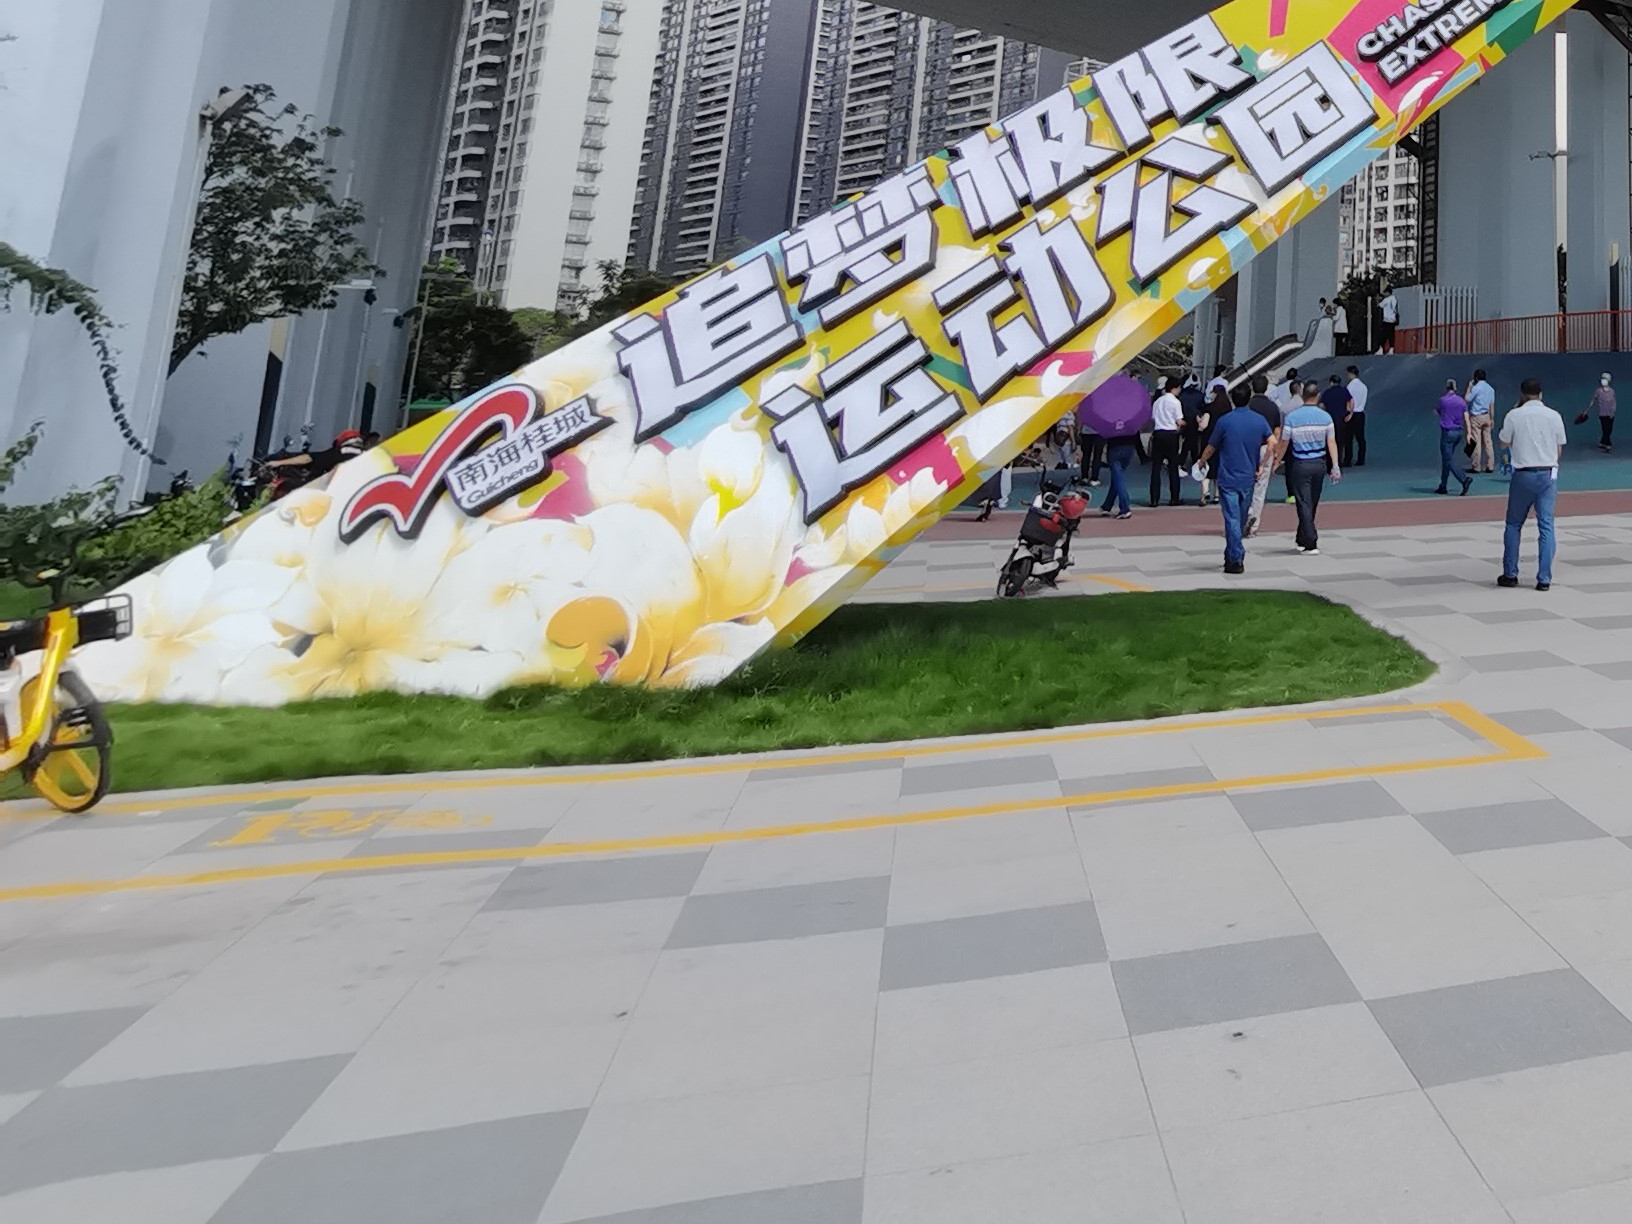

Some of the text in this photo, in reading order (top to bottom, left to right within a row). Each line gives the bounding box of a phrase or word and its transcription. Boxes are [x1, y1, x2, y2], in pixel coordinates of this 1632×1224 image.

[613, 14, 1257, 443] 追梦极限
[764, 41, 1378, 524] 运动公园
[455, 404, 589, 491] 南海桂城
[467, 458, 540, 505] Guicheng
